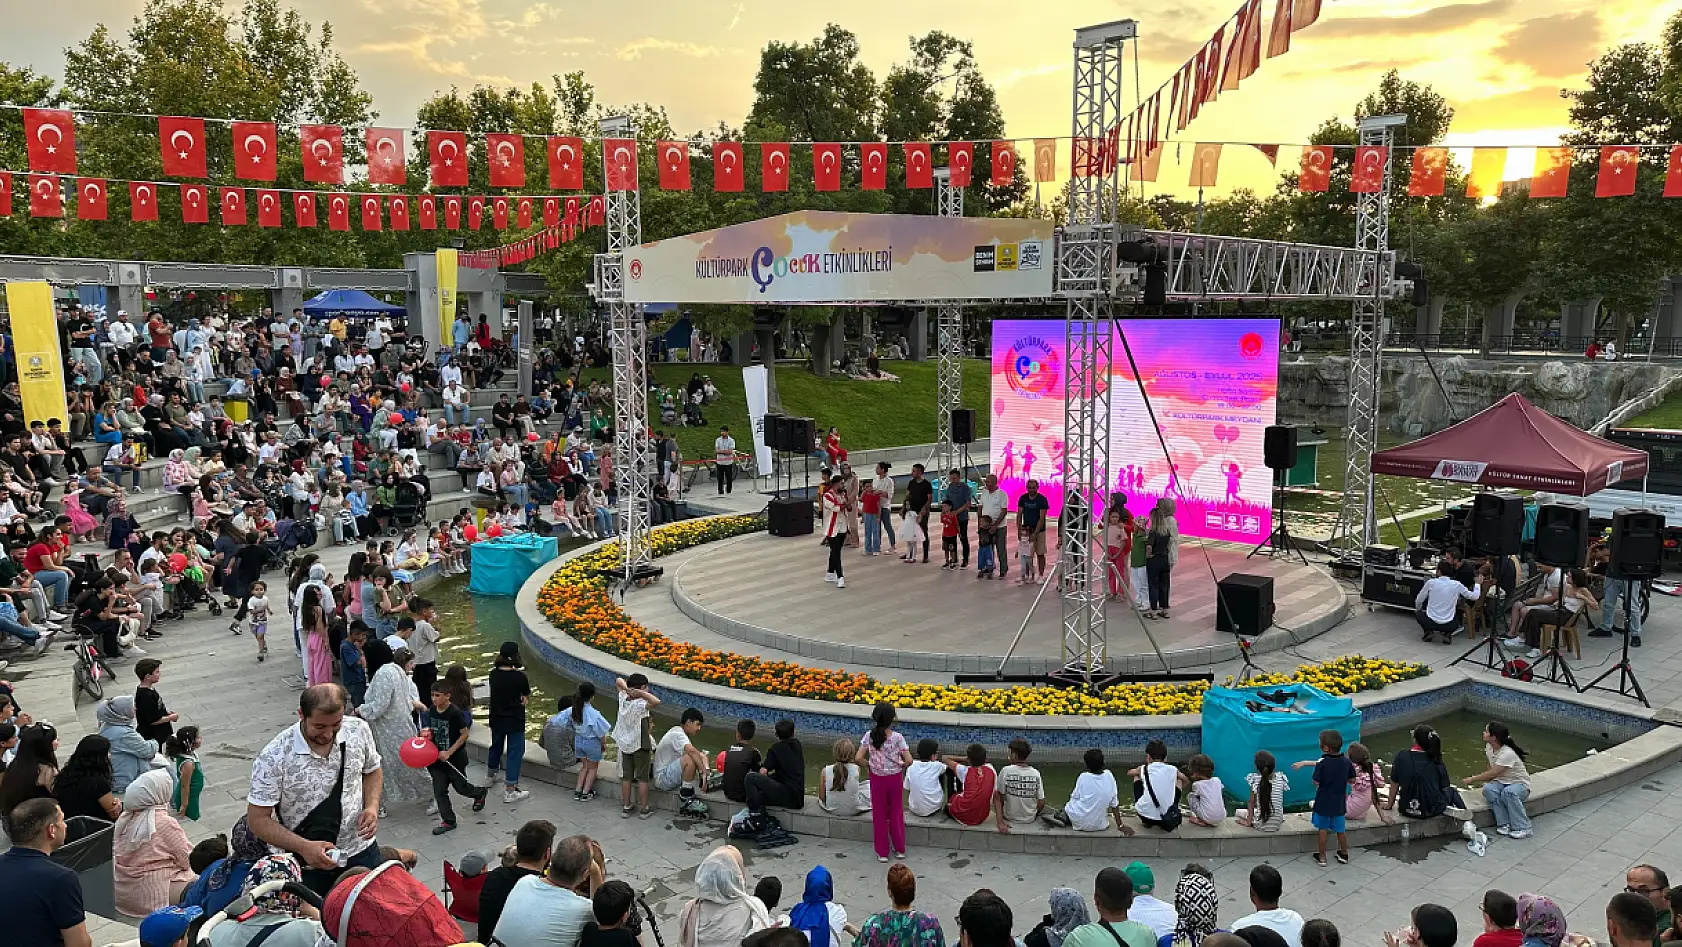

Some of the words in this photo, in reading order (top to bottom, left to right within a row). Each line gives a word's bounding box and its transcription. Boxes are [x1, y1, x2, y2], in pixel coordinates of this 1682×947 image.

[695, 256, 749, 279] KÜLTÜRPARK
[824, 246, 892, 274] ETKİNLİKLERİ
[1154, 369, 1197, 379] AĞUSTOS
